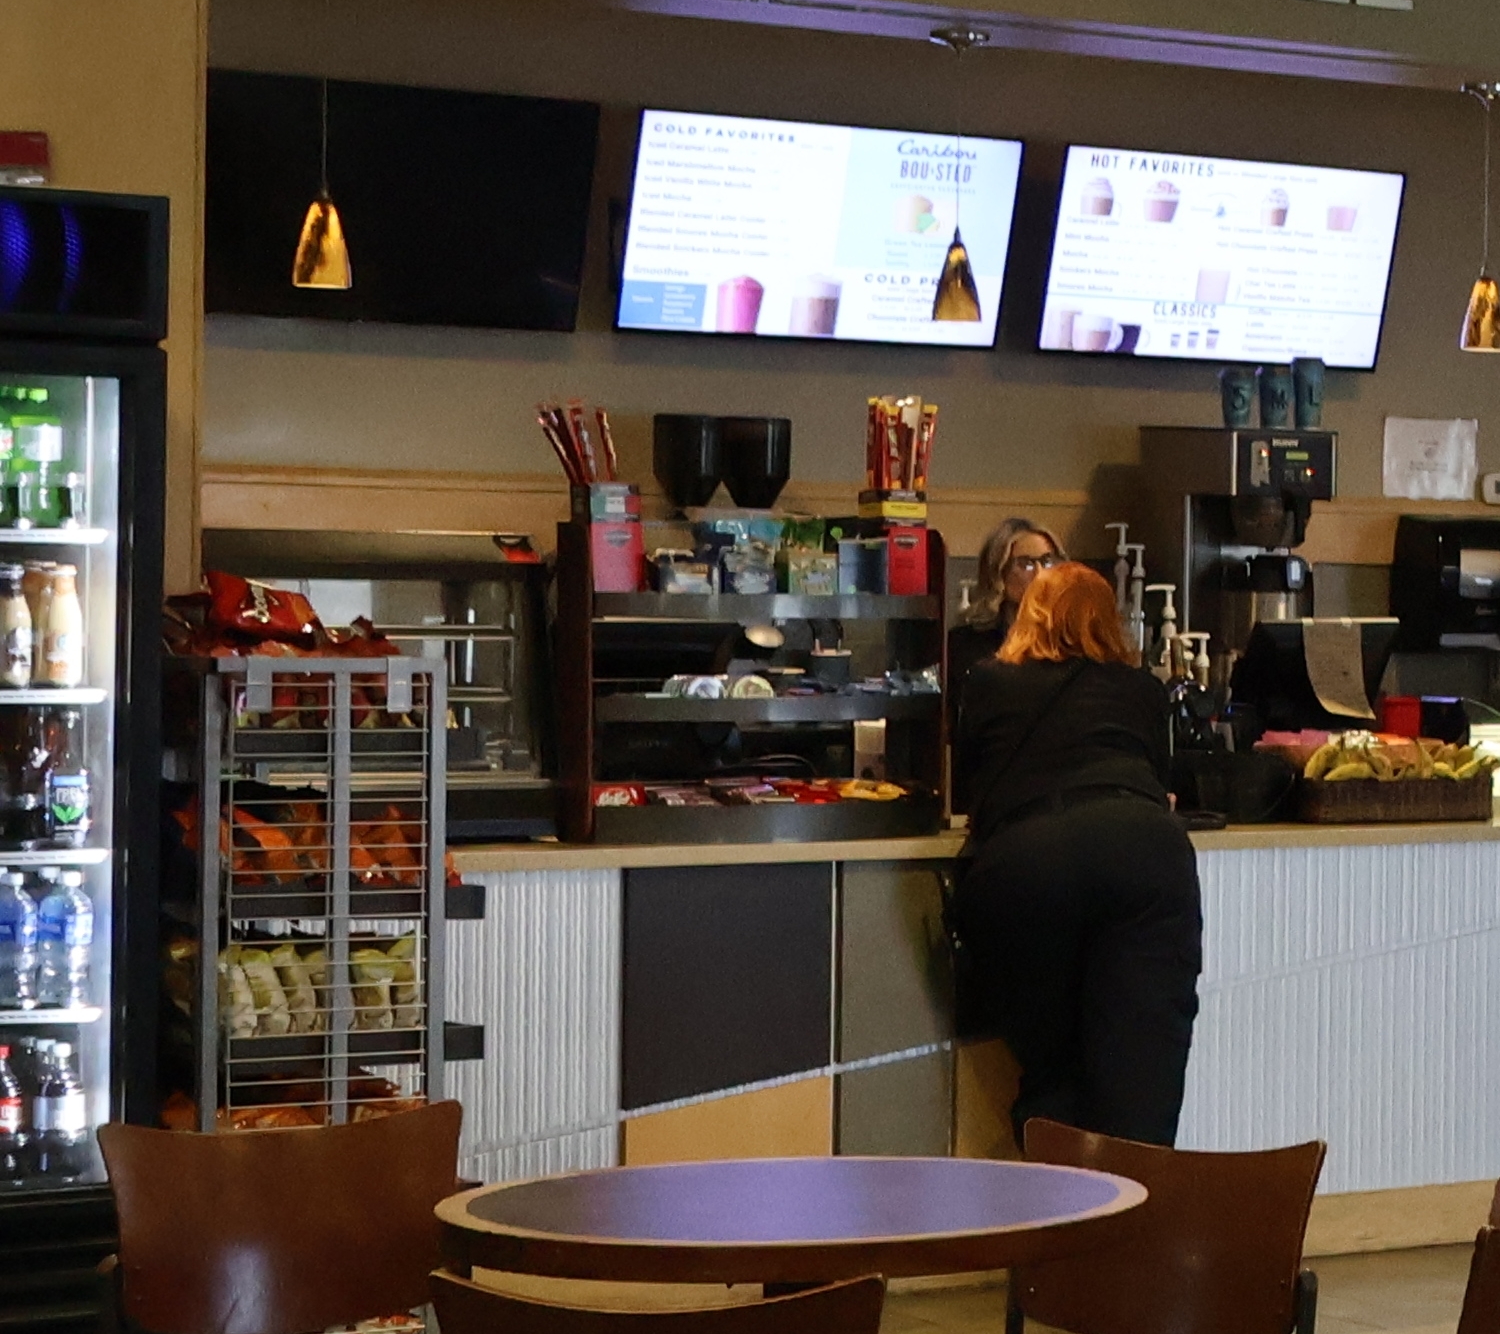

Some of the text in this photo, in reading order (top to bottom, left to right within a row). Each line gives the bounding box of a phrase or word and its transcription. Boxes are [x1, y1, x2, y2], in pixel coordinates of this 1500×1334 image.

[654, 123, 795, 143] COLD FAVORITES
[897, 138, 977, 160] Caribou
[1091, 153, 1121, 169] HOT
[1129, 157, 1215, 177] FAVORITES
[633, 264, 690, 277] Smoothies
[864, 273, 912, 286] COLD
[1153, 300, 1217, 319] CLASSICS
